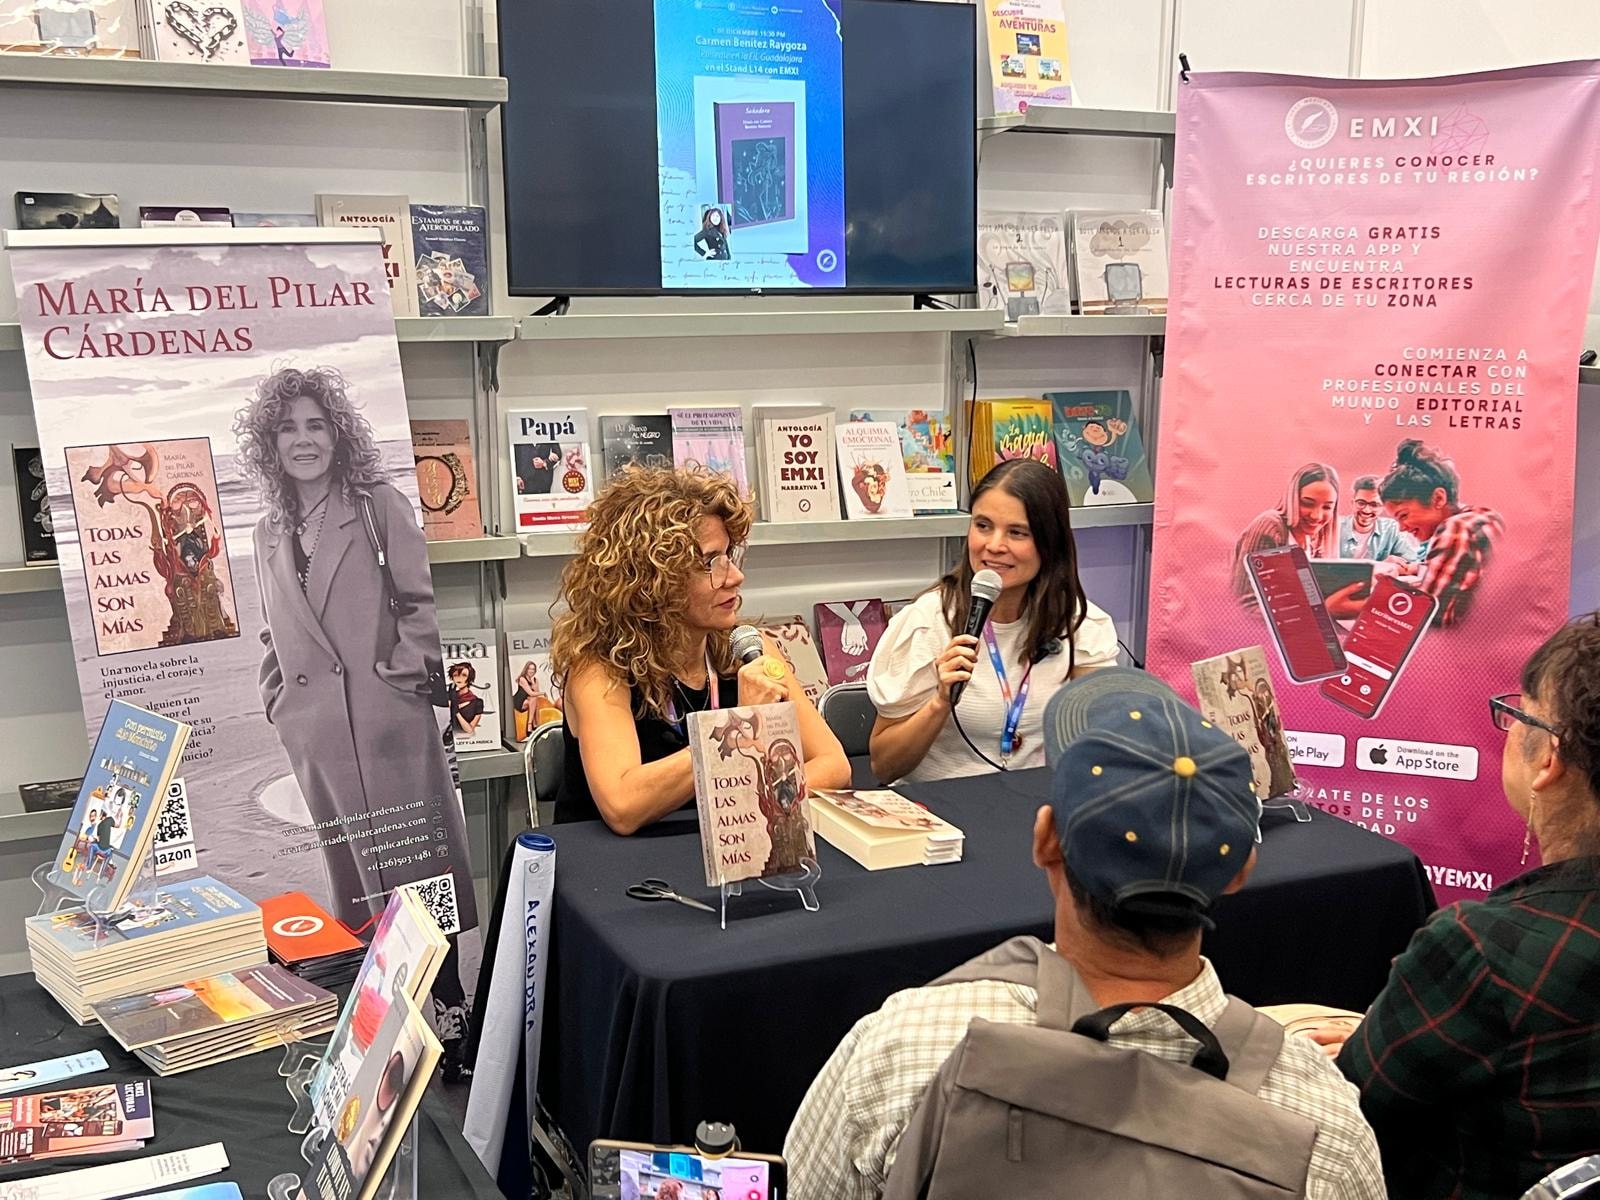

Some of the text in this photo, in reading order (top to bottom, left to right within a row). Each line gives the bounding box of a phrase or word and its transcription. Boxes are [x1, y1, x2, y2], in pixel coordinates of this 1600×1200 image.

[999, 19, 1056, 33] AVENTURAS
[696, 36, 731, 46] Carmen
[770, 40, 807, 52] Raygoza
[716, 63, 724, 72] el
[726, 64, 748, 73] Stand
[780, 66, 799, 75] EMXI
[1350, 116, 1439, 138] EMXI
[1288, 154, 1496, 172] ¿QUIERES CONOCER
[1246, 166, 1539, 186] ESCRITORES DE TU REGIÓN?
[340, 214, 396, 224] ANTOLOGÍA
[412, 216, 450, 224] ESTAMPAS
[1016, 233, 1024, 243] 2
[1258, 226, 1442, 240] DESCARGA GRATIS
[1118, 236, 1124, 247] 1
[1268, 244, 1422, 256] NUESTRA APP Y
[1289, 260, 1405, 273] ENCUENTRA
[1214, 276, 1474, 290] LECTURAS DE ESCRITORES
[35, 276, 375, 317] MARÍA DEL PILAR
[1252, 293, 1438, 308] CERCA DE TU ZONA
[43, 323, 253, 360] CÁRDENAS
[1402, 348, 1528, 362] COMIENZA A
[1374, 364, 1526, 378] CONECTAR CON
[1322, 379, 1525, 396] PROFESIONALES DEL
[1332, 396, 1523, 412] MUNDO EDITORIAL
[520, 415, 576, 441] Papá
[778, 424, 822, 432] ANTOLOGÍA
[1363, 413, 1522, 430] Y LAS LETRAS
[846, 428, 890, 436] ALQUIMIA
[787, 434, 812, 448] YO
[842, 436, 895, 444] EMOCIONAL
[784, 451, 818, 464] SOY
[780, 467, 824, 481] EMXI
[820, 481, 826, 490] 1
[921, 486, 946, 497] Chile
[85, 525, 143, 543] TODAS
[90, 550, 122, 566] LAS
[94, 570, 150, 590] ALMAS
[98, 596, 134, 613] SON
[102, 616, 144, 636] MÍAS
[513, 640, 529, 650] EL
[100, 655, 199, 677] Una novela sobre la
[102, 666, 205, 688] injusticia, el coraje y
[104, 687, 146, 700] el amor.
[184, 696, 200, 706] tan
[182, 706, 192, 716] el
[200, 716, 212, 724] su
[1228, 712, 1250, 726] TODAS
[191, 726, 216, 738] ticia?
[185, 739, 202, 750] ede
[1289, 746, 1329, 762] gle Play
[1396, 745, 1434, 756] Download
[1446, 751, 1460, 759] the
[1396, 756, 1460, 772] App Store
[712, 774, 752, 790] TODAS
[714, 796, 736, 808] LAS
[1362, 792, 1384, 804] DE
[1394, 796, 1430, 810] LOS
[716, 812, 756, 828] ALMAS
[1362, 807, 1384, 820] DE
[1394, 810, 1417, 823] TU
[719, 832, 746, 847] SON
[156, 848, 192, 865] azon
[722, 849, 752, 866] MÍAS
[524, 900, 540, 1033] ALEXANDRA
